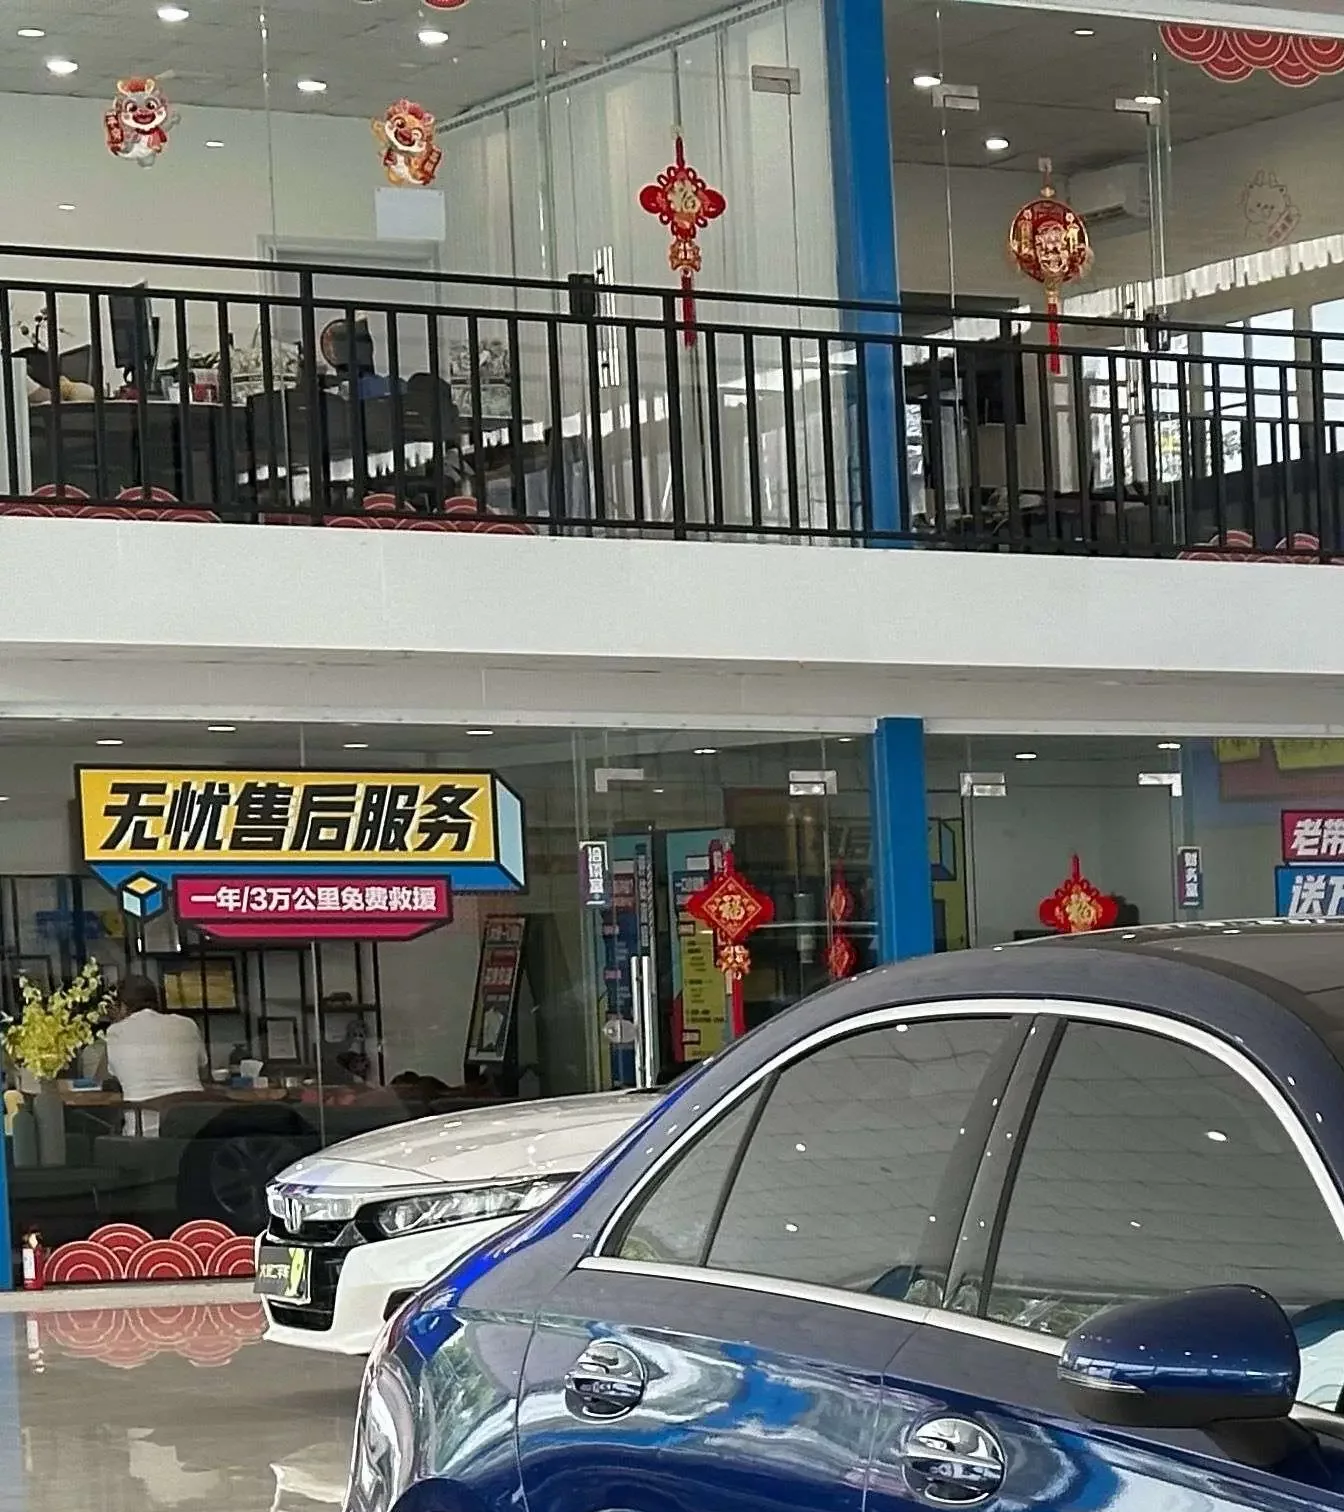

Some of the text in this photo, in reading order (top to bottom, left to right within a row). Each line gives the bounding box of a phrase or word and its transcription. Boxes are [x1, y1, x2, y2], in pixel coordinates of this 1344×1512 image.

[99, 780, 481, 852] 无忧售后服务
[189, 885, 437, 914] 一年/3万公里免费救援
